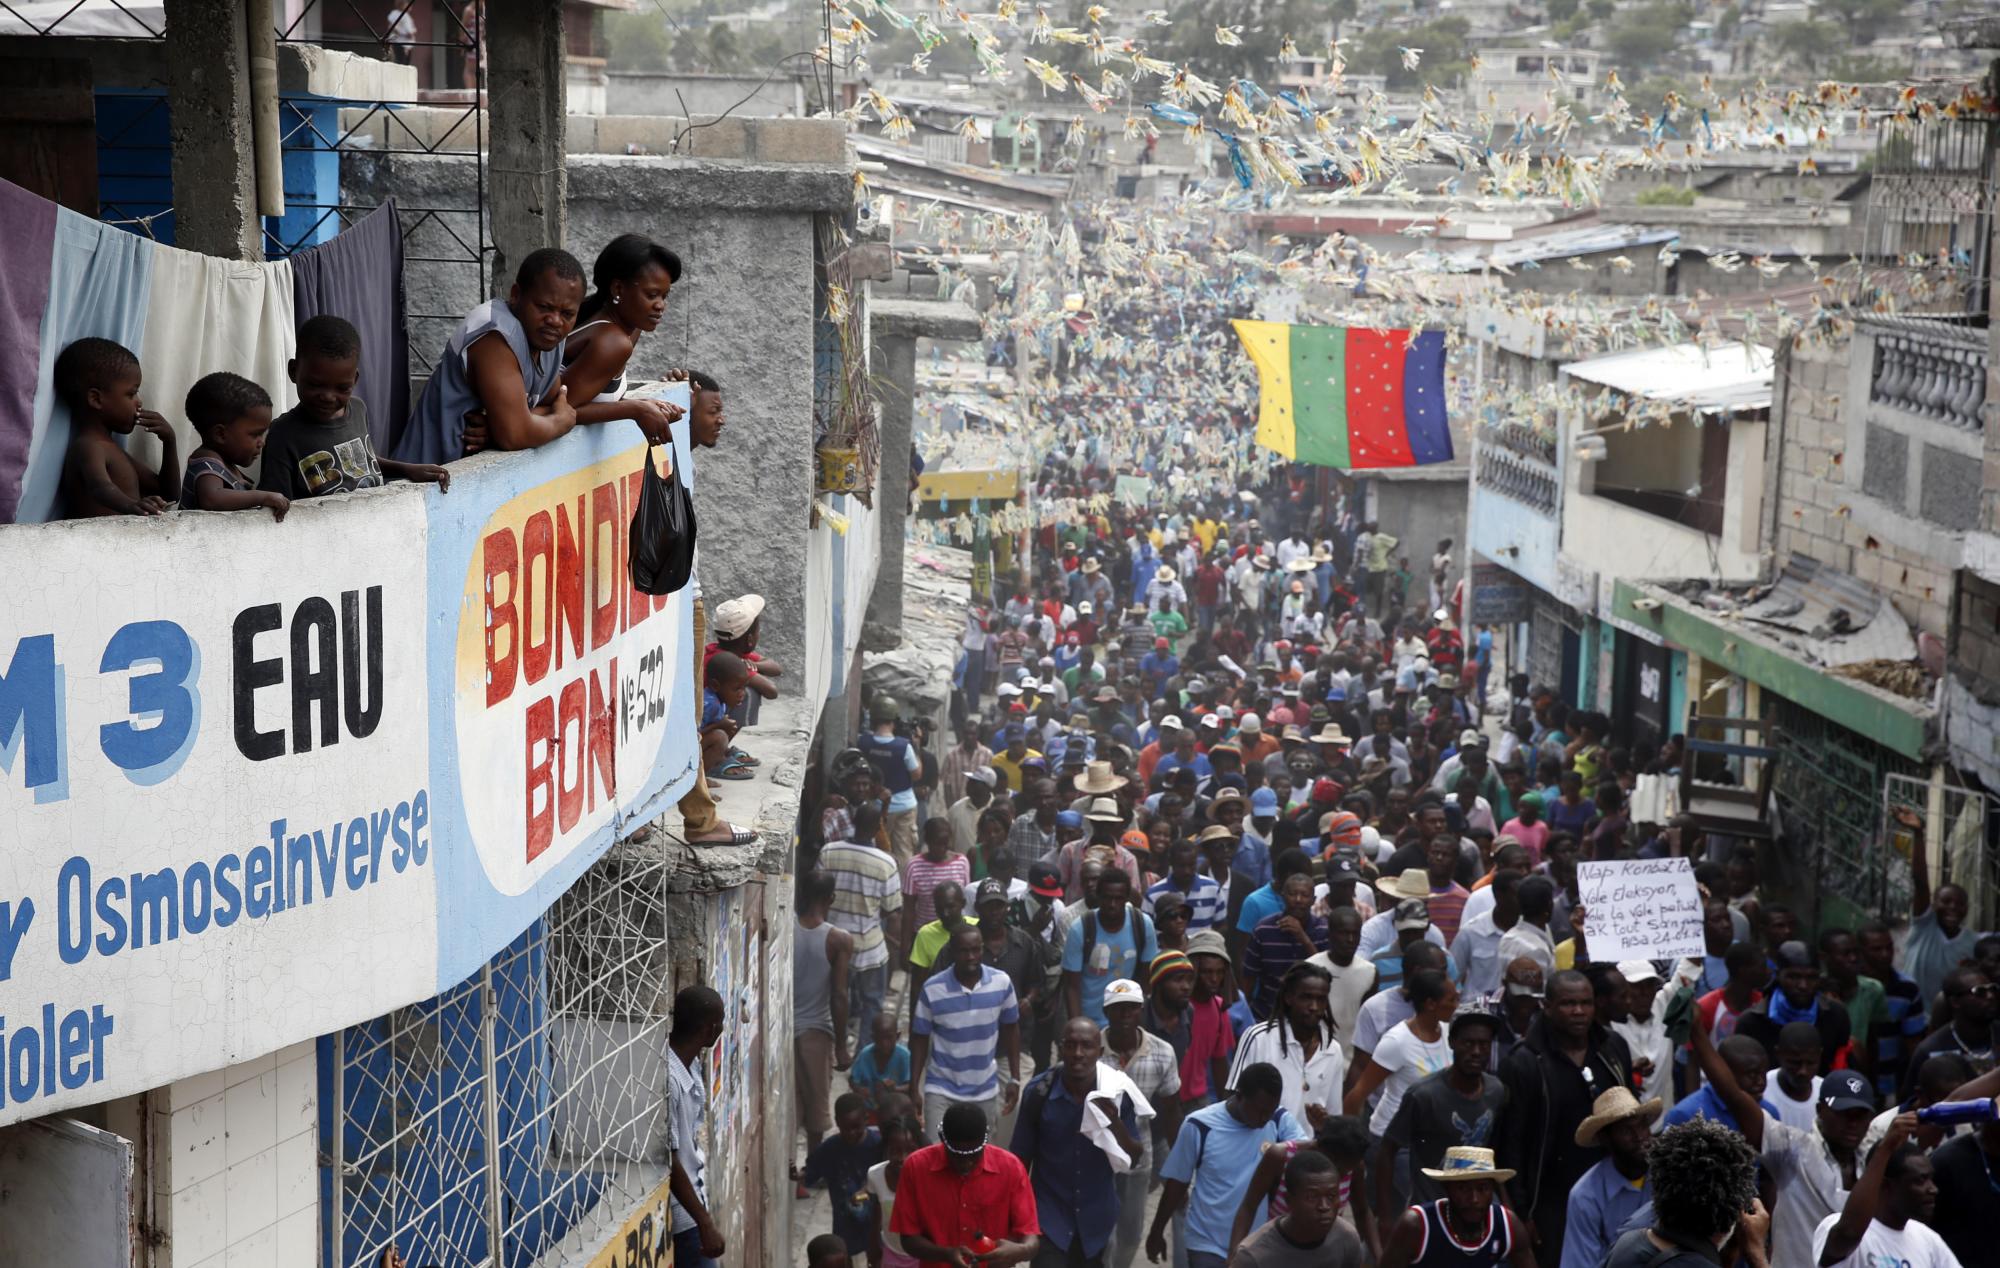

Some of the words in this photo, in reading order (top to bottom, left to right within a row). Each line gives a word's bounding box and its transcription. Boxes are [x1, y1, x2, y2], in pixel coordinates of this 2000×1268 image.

[99, 620, 200, 784] 3
[232, 585, 384, 762] EAU
[526, 657, 618, 864] BON
[637, 645, 666, 733] 522
